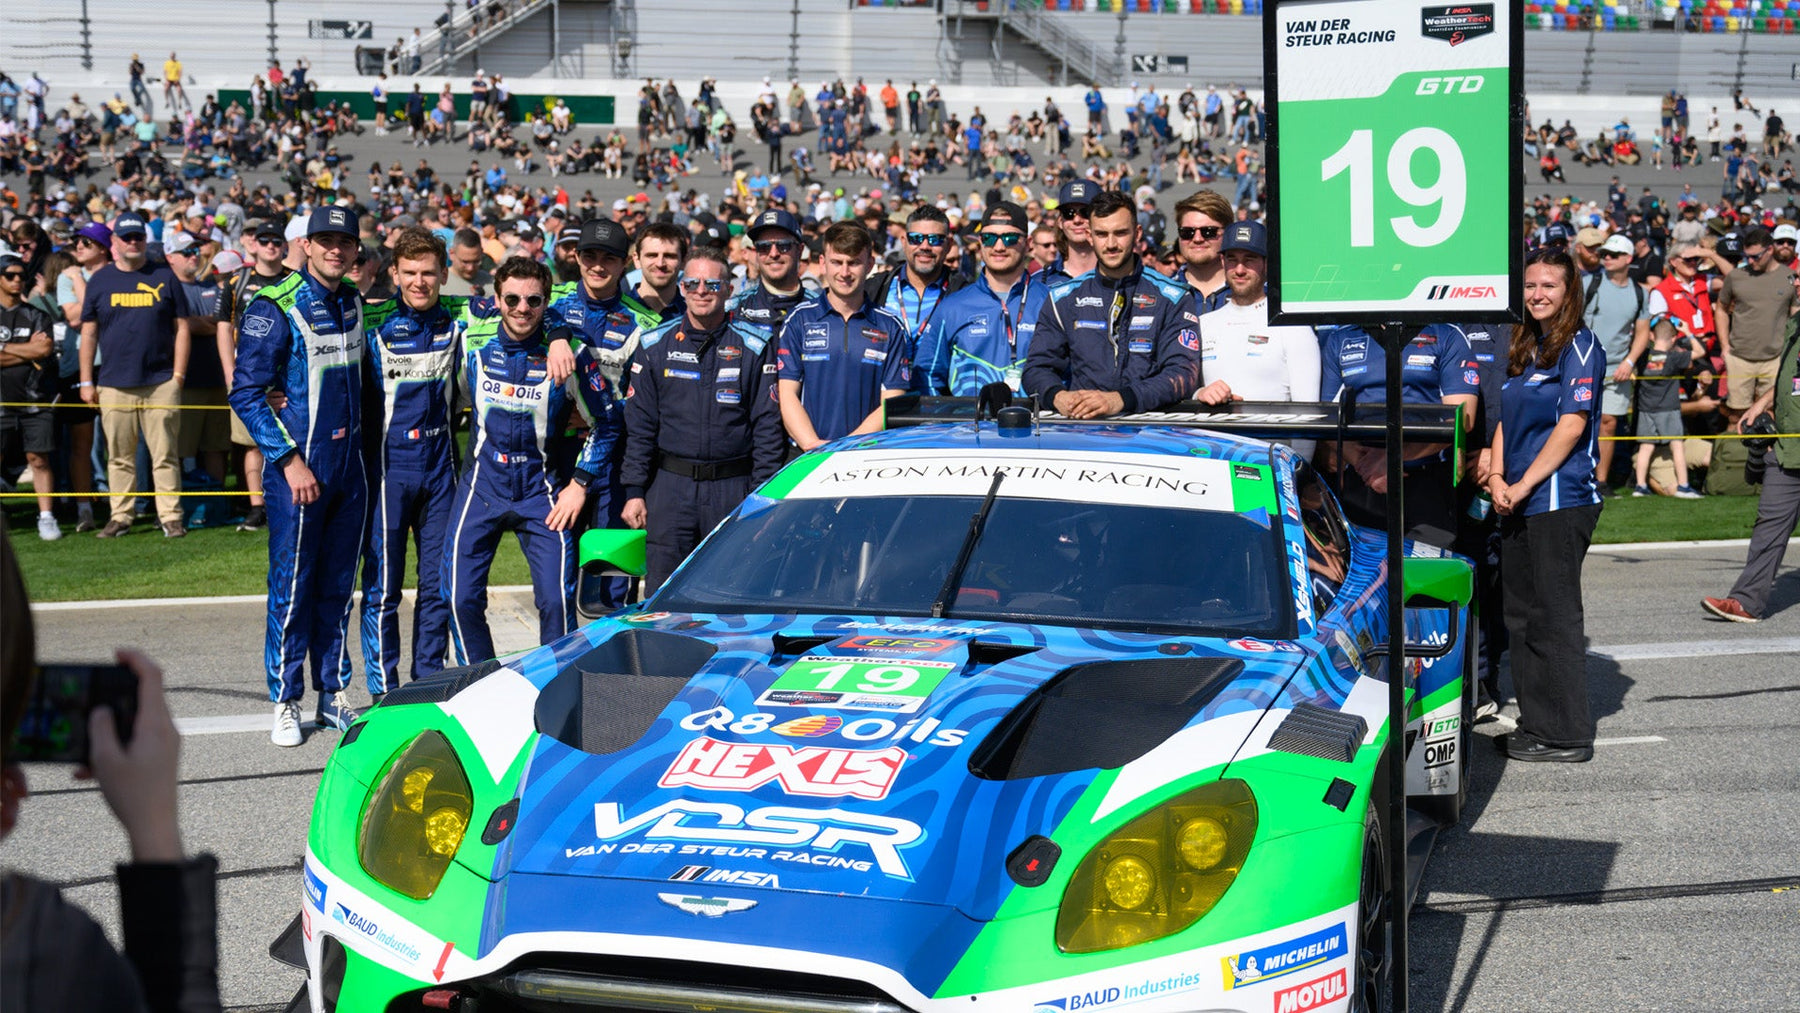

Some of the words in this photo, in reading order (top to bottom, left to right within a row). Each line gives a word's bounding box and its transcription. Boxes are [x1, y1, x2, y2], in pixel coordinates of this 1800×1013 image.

[1286, 20, 1319, 33] VAN
[1320, 18, 1350, 32] DER
[1424, 15, 1492, 25] WeatherTech
[1286, 34, 1333, 47] STEUR
[1336, 30, 1396, 44] RACING
[1415, 75, 1485, 95] GTD
[1321, 126, 1467, 248] 19
[110, 293, 154, 307] PUMA
[1449, 286, 1497, 299] IMSA
[482, 380, 501, 394] Q8
[515, 383, 542, 400] Oils
[819, 465, 930, 484] ASTON
[938, 465, 1067, 480] MARTIN
[1078, 469, 1209, 496] RACING
[1292, 541, 1313, 630] XSHIELD
[866, 639, 936, 648] EFC
[806, 655, 951, 668] WeatherTech
[809, 666, 921, 693] 19
[680, 705, 776, 734] Q8
[841, 716, 970, 746] Oils
[1434, 717, 1459, 733] GTD
[1424, 742, 1455, 764] OMP
[662, 738, 906, 798] HEXIS
[594, 799, 925, 880] VDSR
[565, 843, 617, 858] VAN
[620, 843, 675, 854] DER
[682, 844, 767, 859] STEUR
[774, 850, 874, 872] RACING
[703, 869, 780, 888] IMSA
[349, 912, 378, 936] BAUD
[376, 929, 422, 962] Industries
[1263, 935, 1339, 972] MICHELIN
[1069, 987, 1121, 1011] BAUD
[1123, 972, 1200, 1000] Industries
[1277, 974, 1345, 1013] MOTUL
